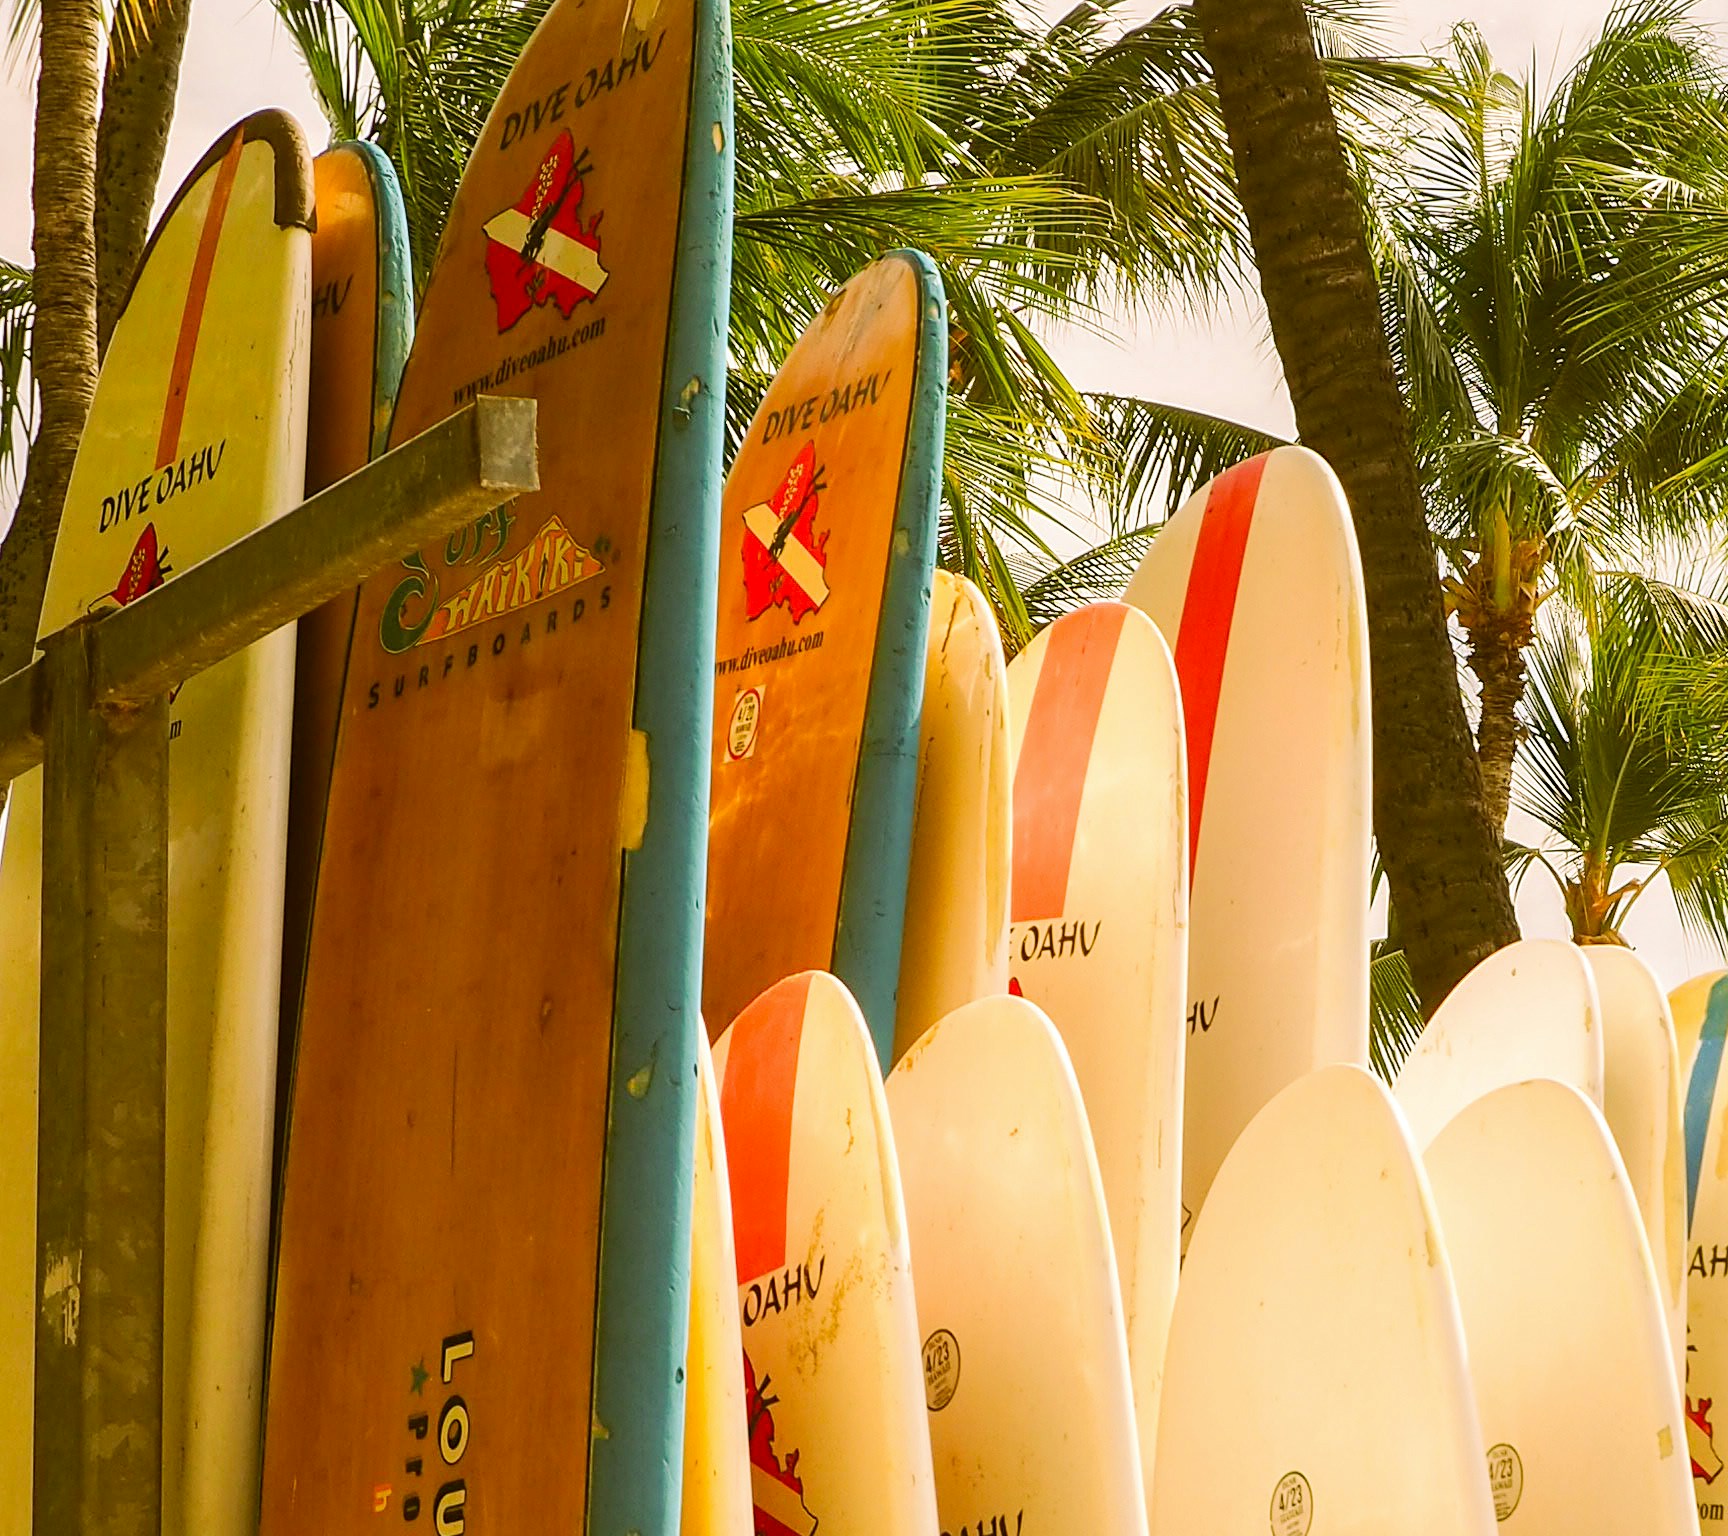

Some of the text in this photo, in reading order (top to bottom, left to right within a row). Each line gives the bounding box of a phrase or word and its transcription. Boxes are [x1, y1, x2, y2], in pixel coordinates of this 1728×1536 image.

[500, 31, 666, 151] DIVE OAHU
[312, 274, 353, 319] HU
[453, 316, 606, 405] www.diveoahu.com
[762, 370, 892, 445] DIVE OAHU
[99, 440, 226, 534] DIVE OAHU
[368, 585, 612, 709] SURFBOARDS
[715, 631, 824, 676] ww.diveoahu.com
[1020, 920, 1102, 962] OAHU
[1187, 995, 1220, 1035] HU
[743, 1254, 825, 1327] OAHU
[402, 1413, 429, 1524] Pro
